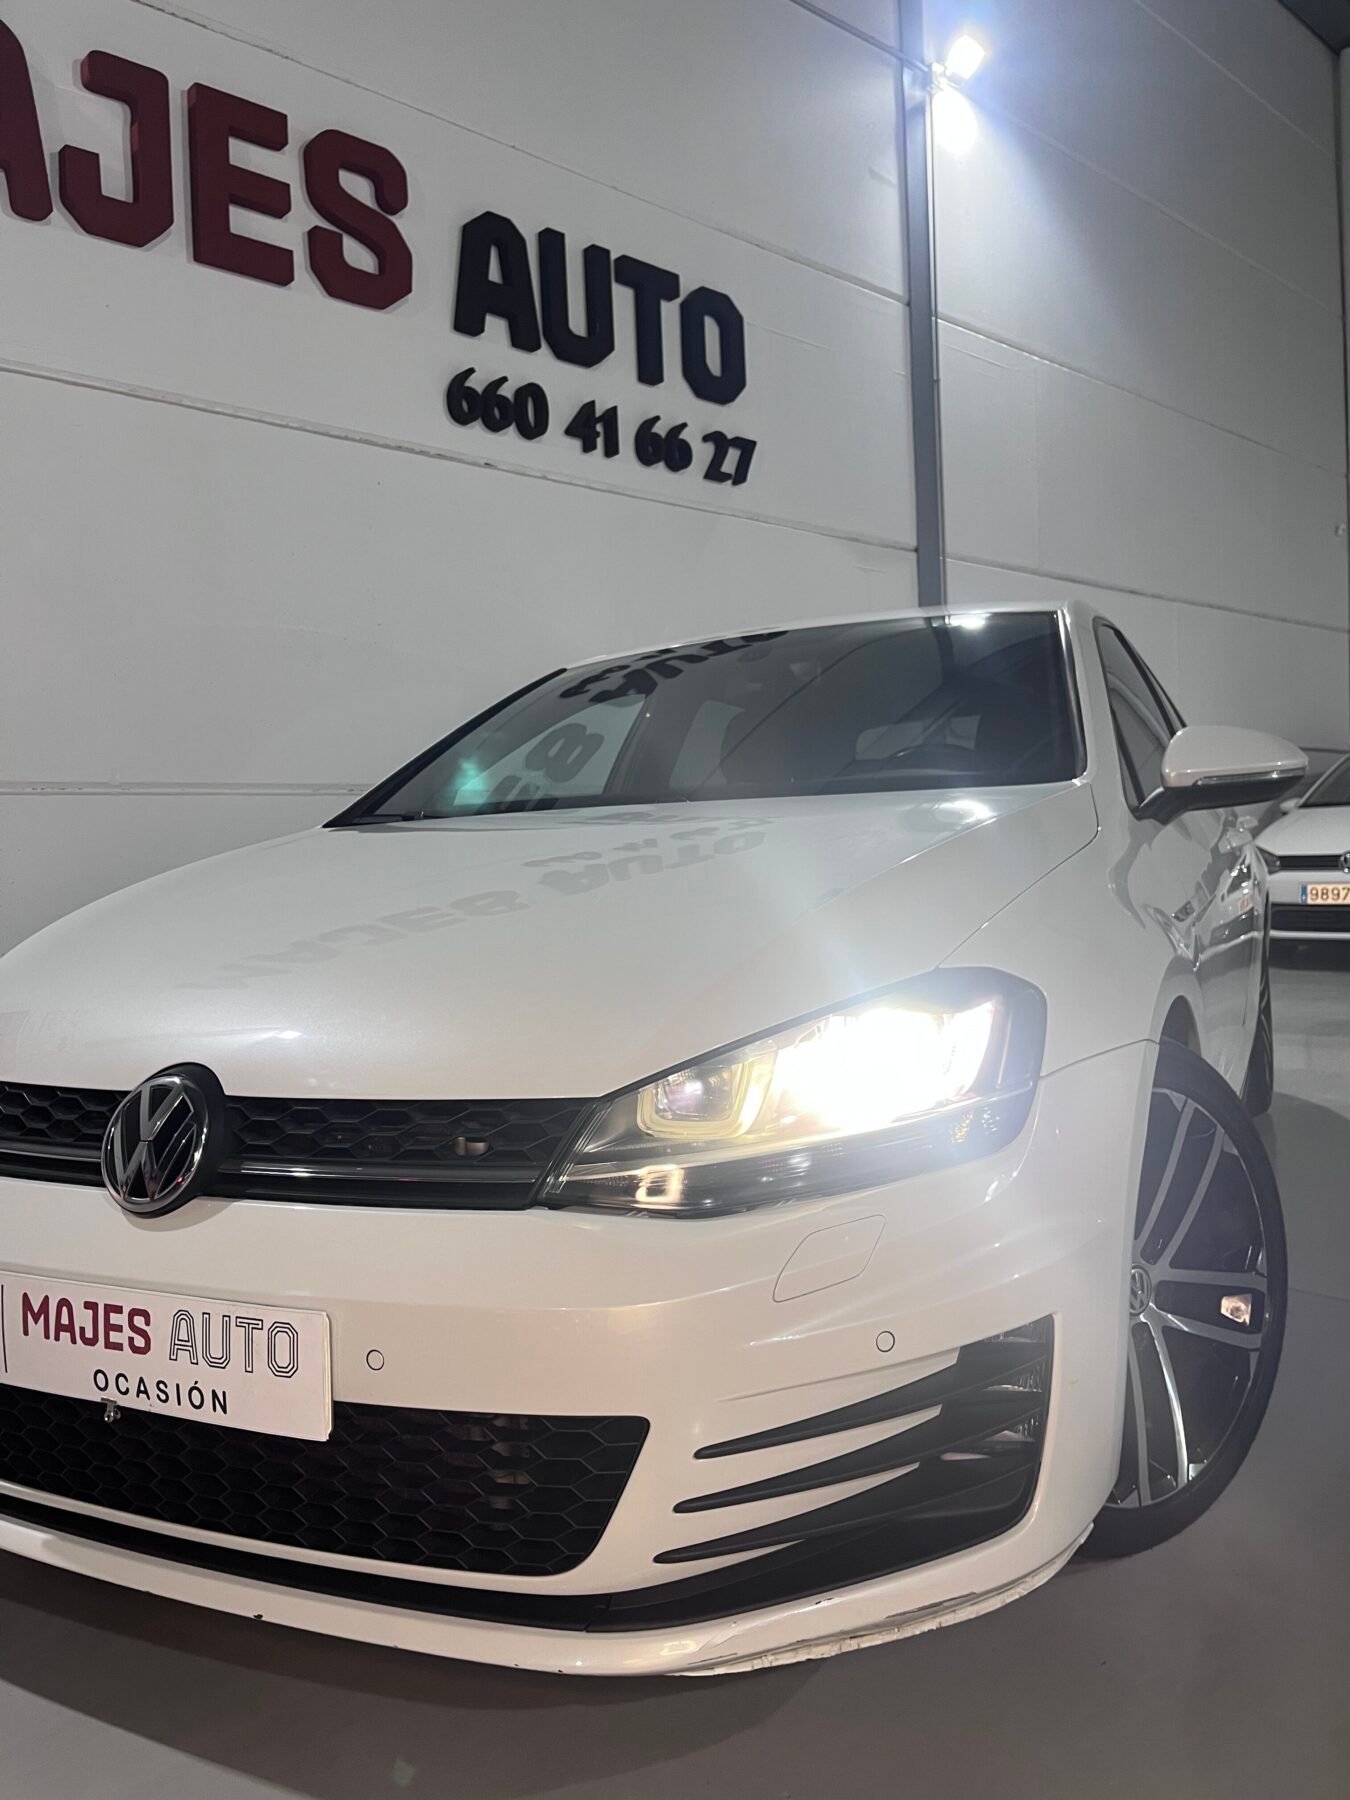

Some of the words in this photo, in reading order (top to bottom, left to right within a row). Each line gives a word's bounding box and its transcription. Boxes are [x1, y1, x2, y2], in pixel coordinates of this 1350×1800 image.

[453, 210, 746, 405] AUTO
[446, 367, 549, 440] 660
[564, 400, 620, 458] 41
[634, 415, 693, 472] 66
[702, 431, 757, 486] 27
[1310, 886, 1350, 901] 9897
[22, 1291, 151, 1355] MAJES
[169, 1309, 299, 1378] AUTO
[93, 1368, 228, 1415] OCASIÓN
